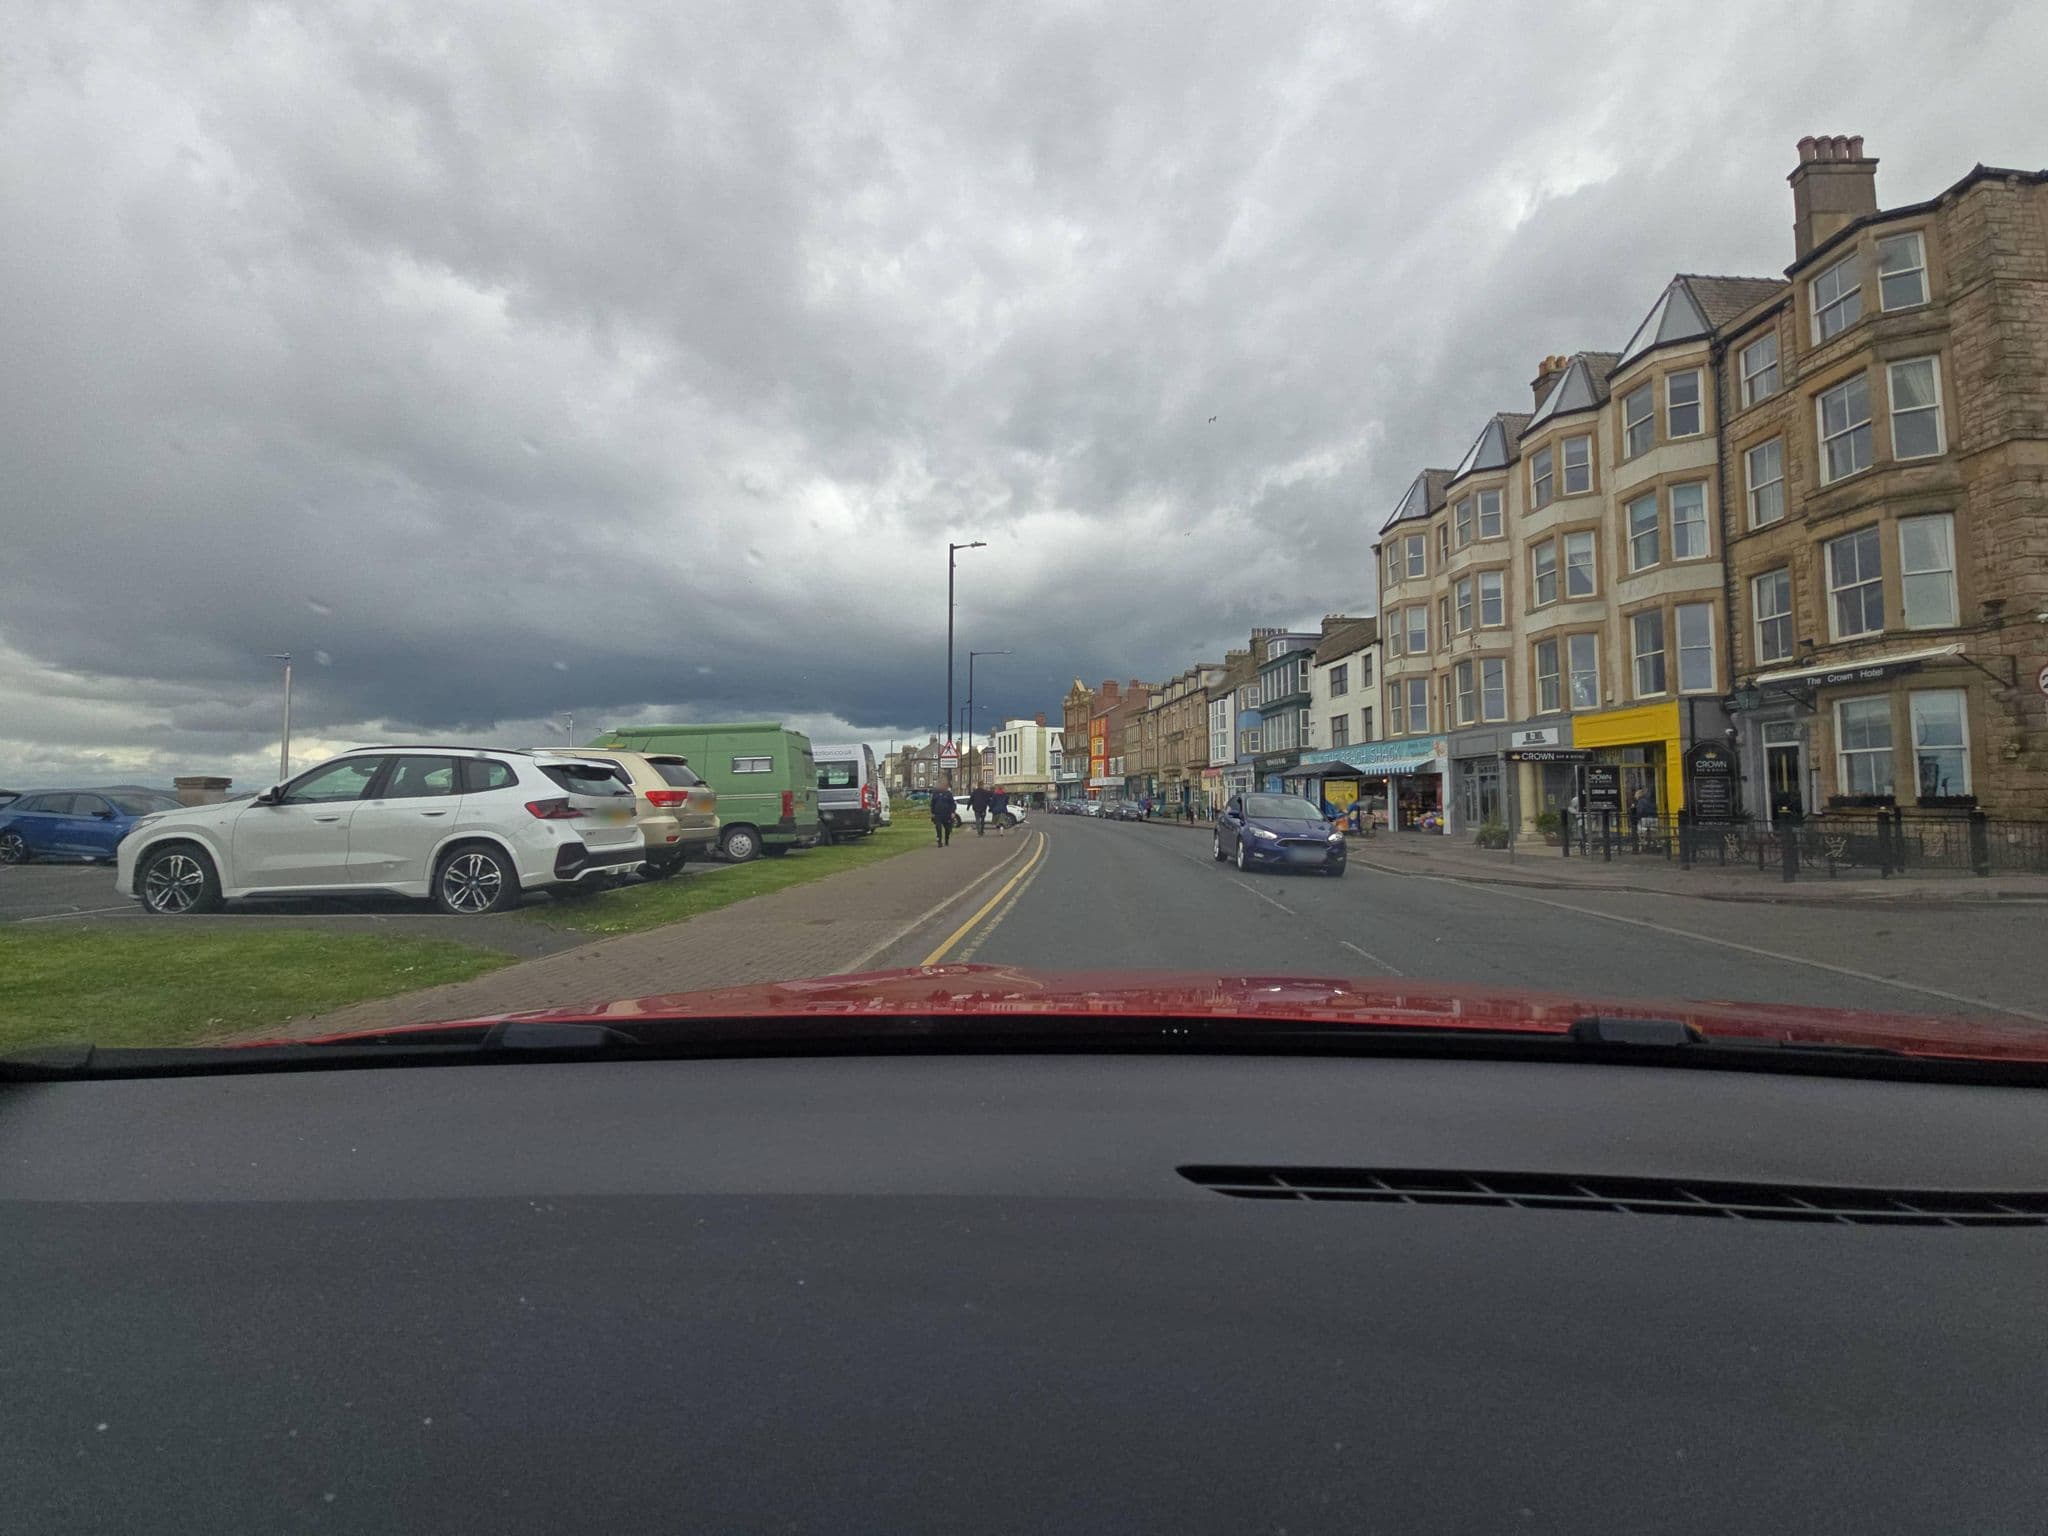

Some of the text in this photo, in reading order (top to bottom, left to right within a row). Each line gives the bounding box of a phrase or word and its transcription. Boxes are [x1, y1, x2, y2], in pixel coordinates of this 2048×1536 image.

[1807, 668, 1883, 686] The Crown Hotel
[1341, 748, 1366, 765] BEACH
[1370, 743, 1401, 763] SHACK
[1521, 752, 1555, 761] CROWN
[1696, 760, 1727, 768] CROWN
